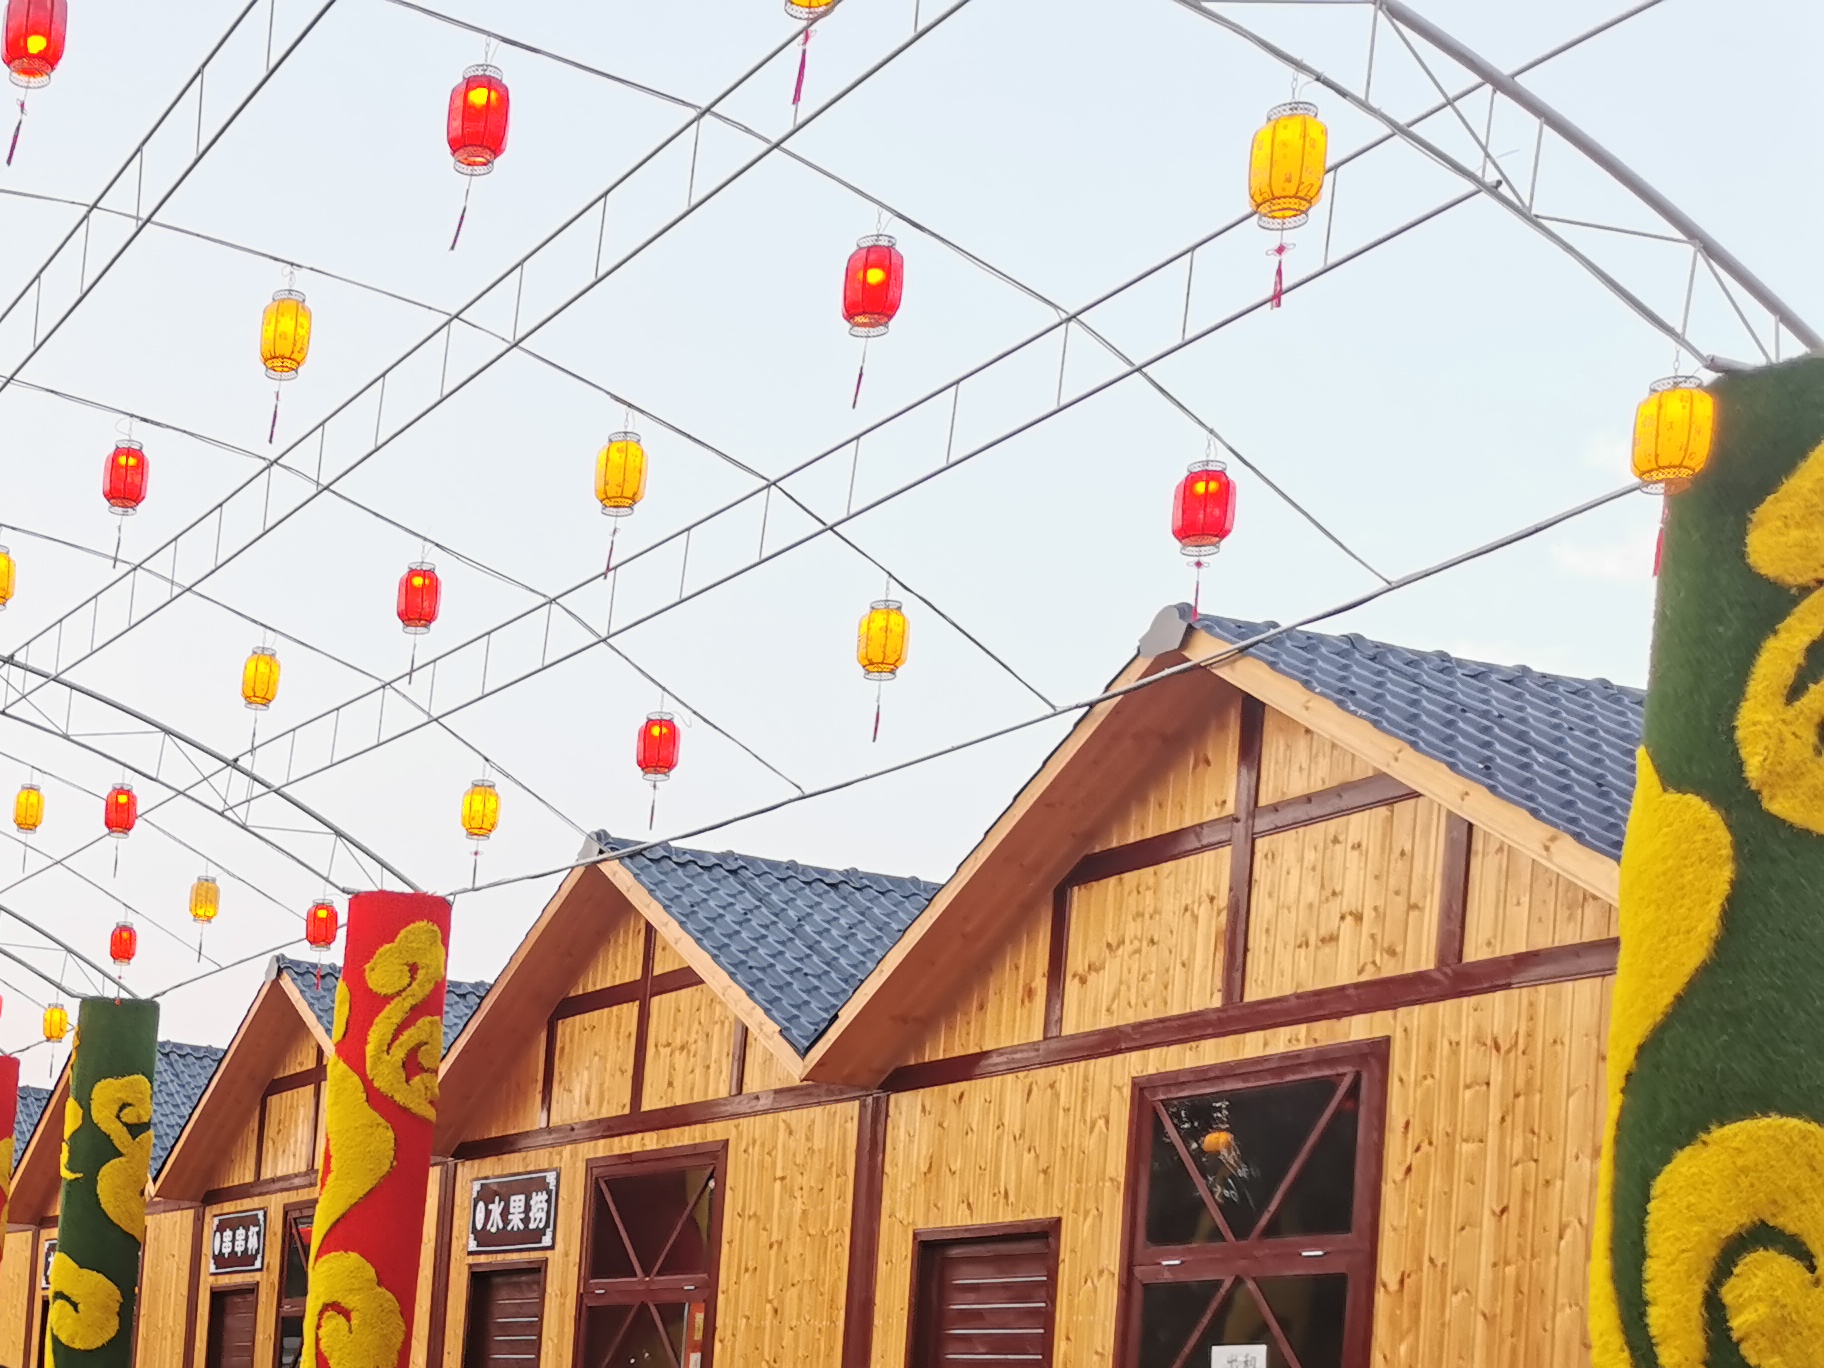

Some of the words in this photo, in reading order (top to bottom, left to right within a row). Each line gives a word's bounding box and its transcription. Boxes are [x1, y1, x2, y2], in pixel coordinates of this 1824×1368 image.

[486, 1190, 548, 1232] 水果捞
[221, 1225, 259, 1258] 串串杯
